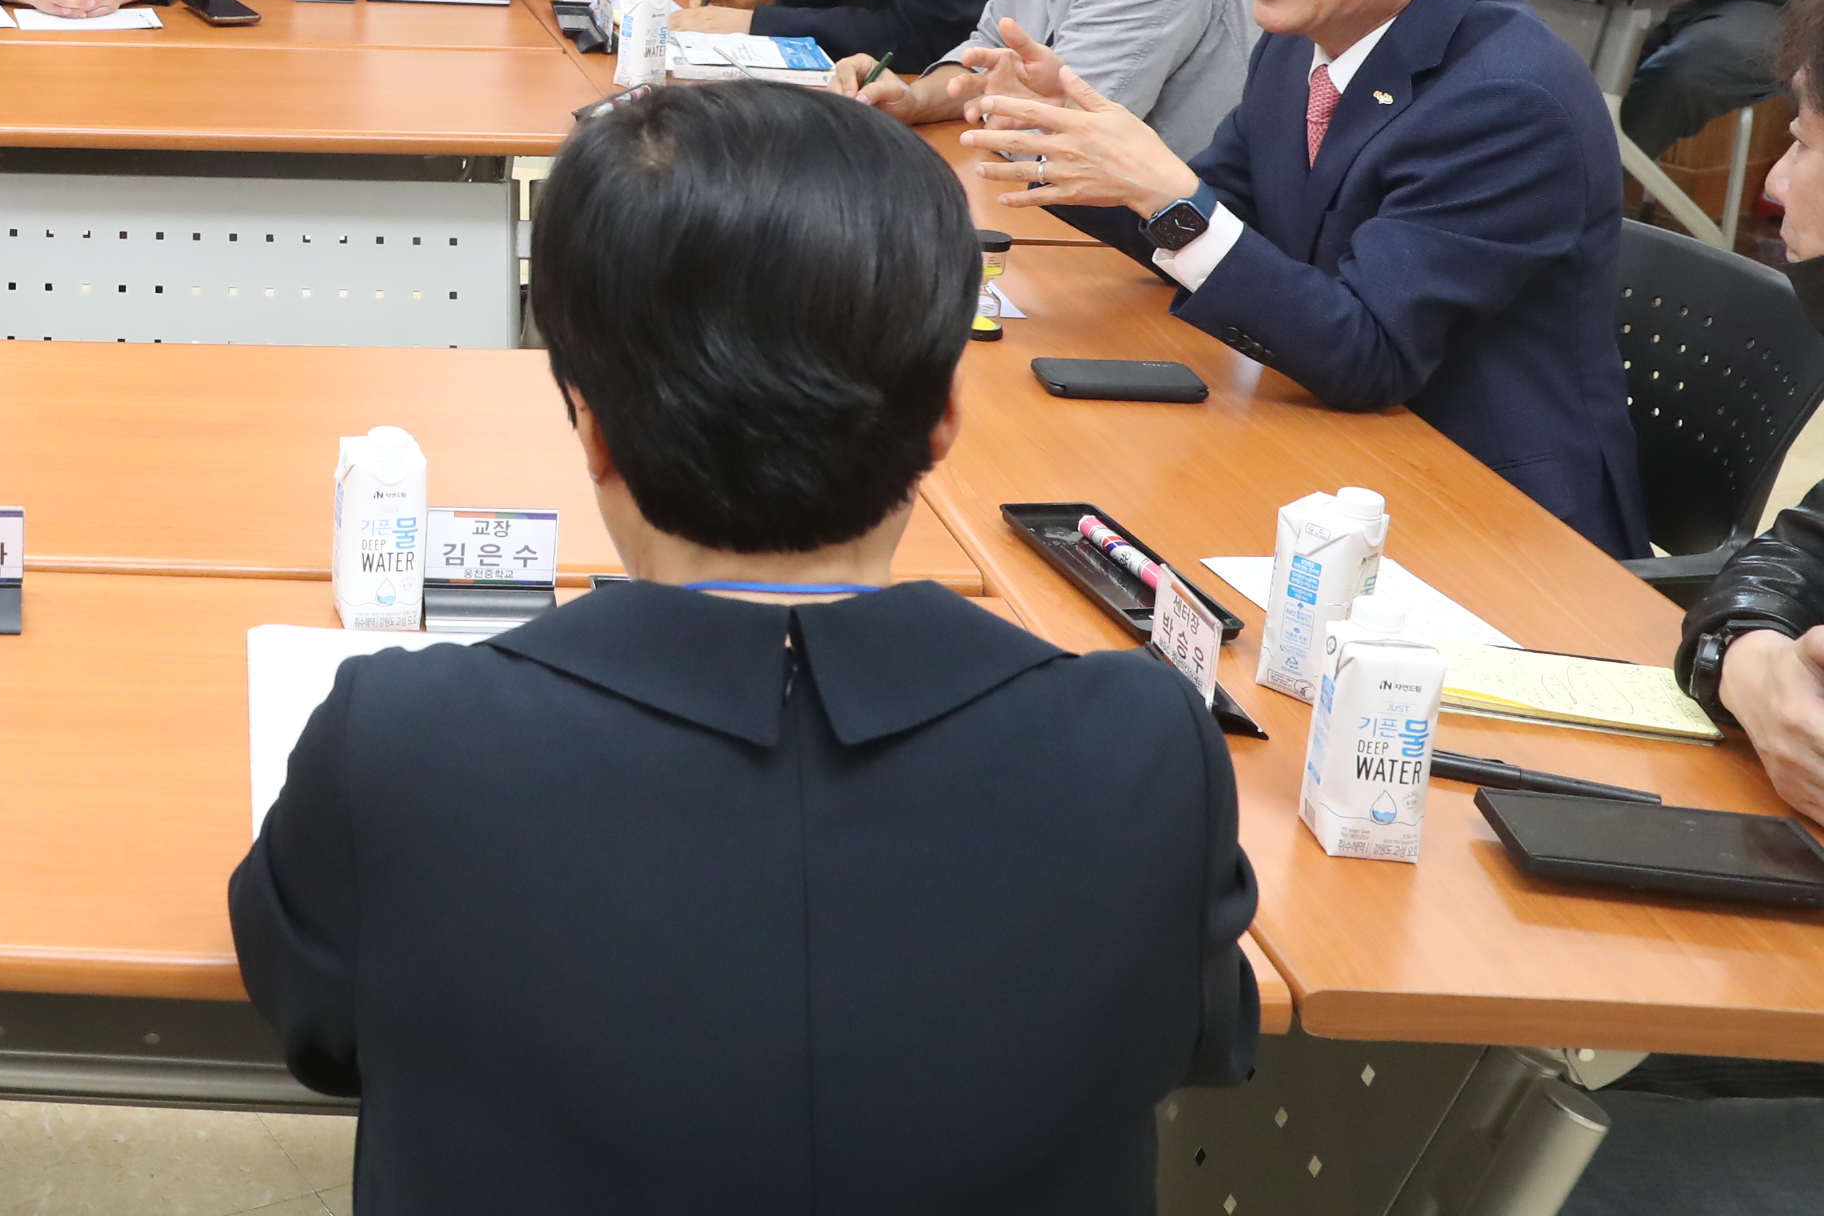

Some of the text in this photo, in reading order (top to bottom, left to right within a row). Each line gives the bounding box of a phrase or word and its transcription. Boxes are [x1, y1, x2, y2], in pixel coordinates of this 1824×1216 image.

[360, 517, 419, 550] 기픈 물
[472, 519, 511, 538] 교장
[361, 539, 386, 551] DEEP
[361, 551, 415, 573] WATER
[464, 568, 514, 579] 웅천중학교
[1173, 595, 1200, 636] 센터장
[1394, 683, 1422, 693] 자연드림
[1385, 704, 1410, 714] JUST
[1358, 716, 1430, 758] 기픈 물
[1357, 739, 1389, 755] DEEP
[1356, 755, 1423, 785] WATER
[1393, 845, 1407, 858] 고성
